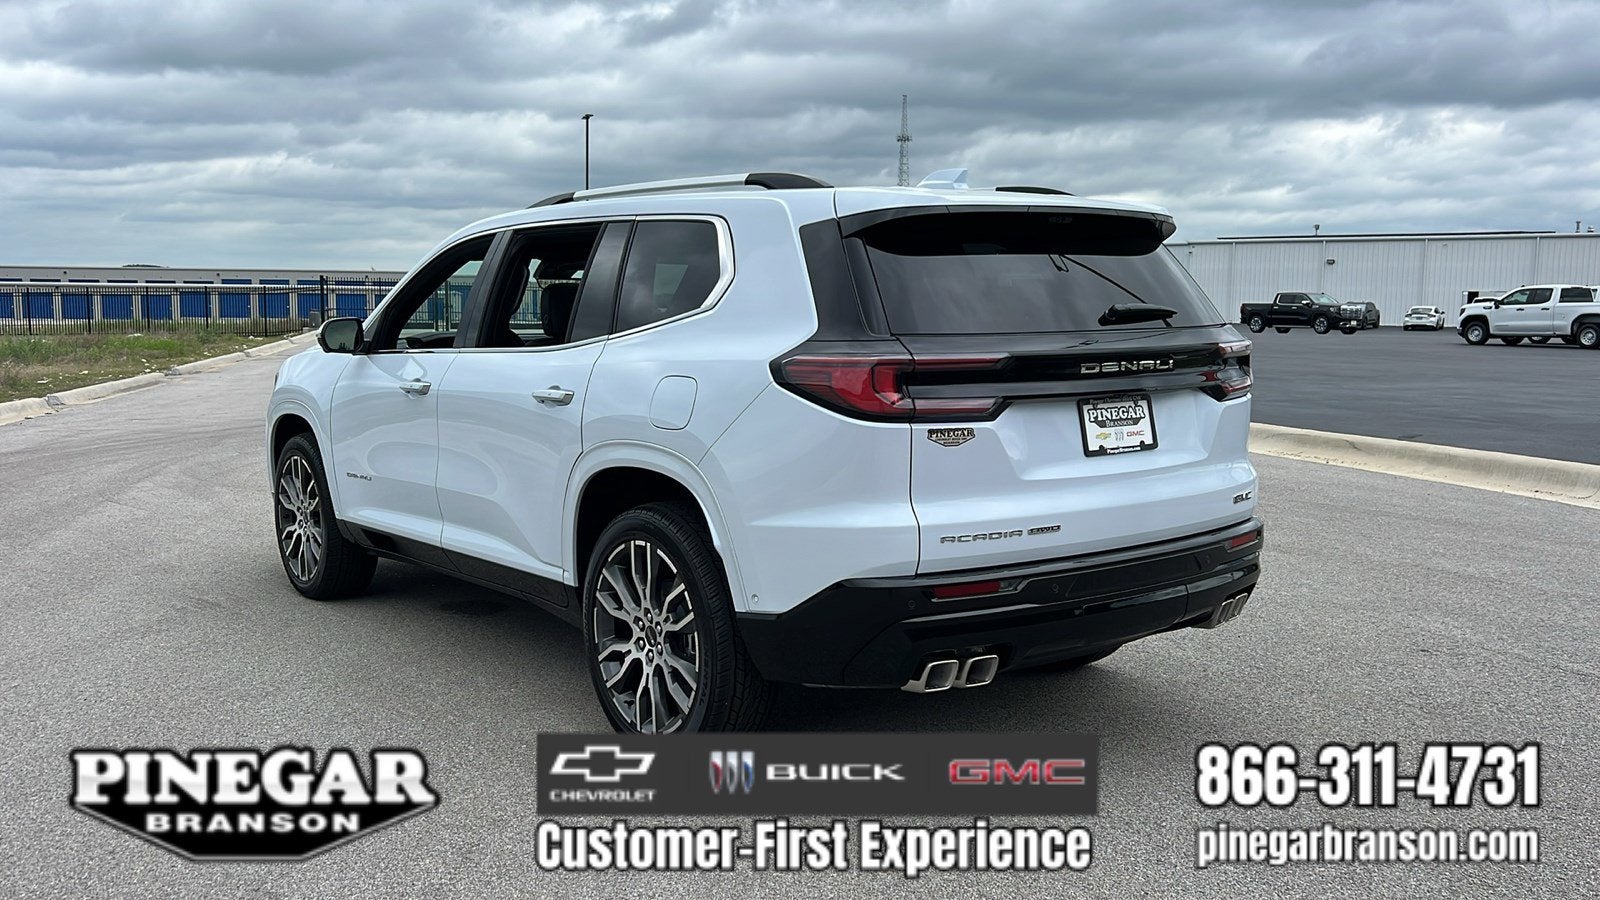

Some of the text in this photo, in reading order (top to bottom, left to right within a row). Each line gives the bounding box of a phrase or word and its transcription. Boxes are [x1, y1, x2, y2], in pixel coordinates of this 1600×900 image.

[1080, 359, 1174, 374] DENALI
[1088, 405, 1146, 422] PINEGAR
[929, 429, 974, 439] PINEGAR
[1126, 429, 1145, 437] GMC
[939, 529, 1024, 544] ACADIA
